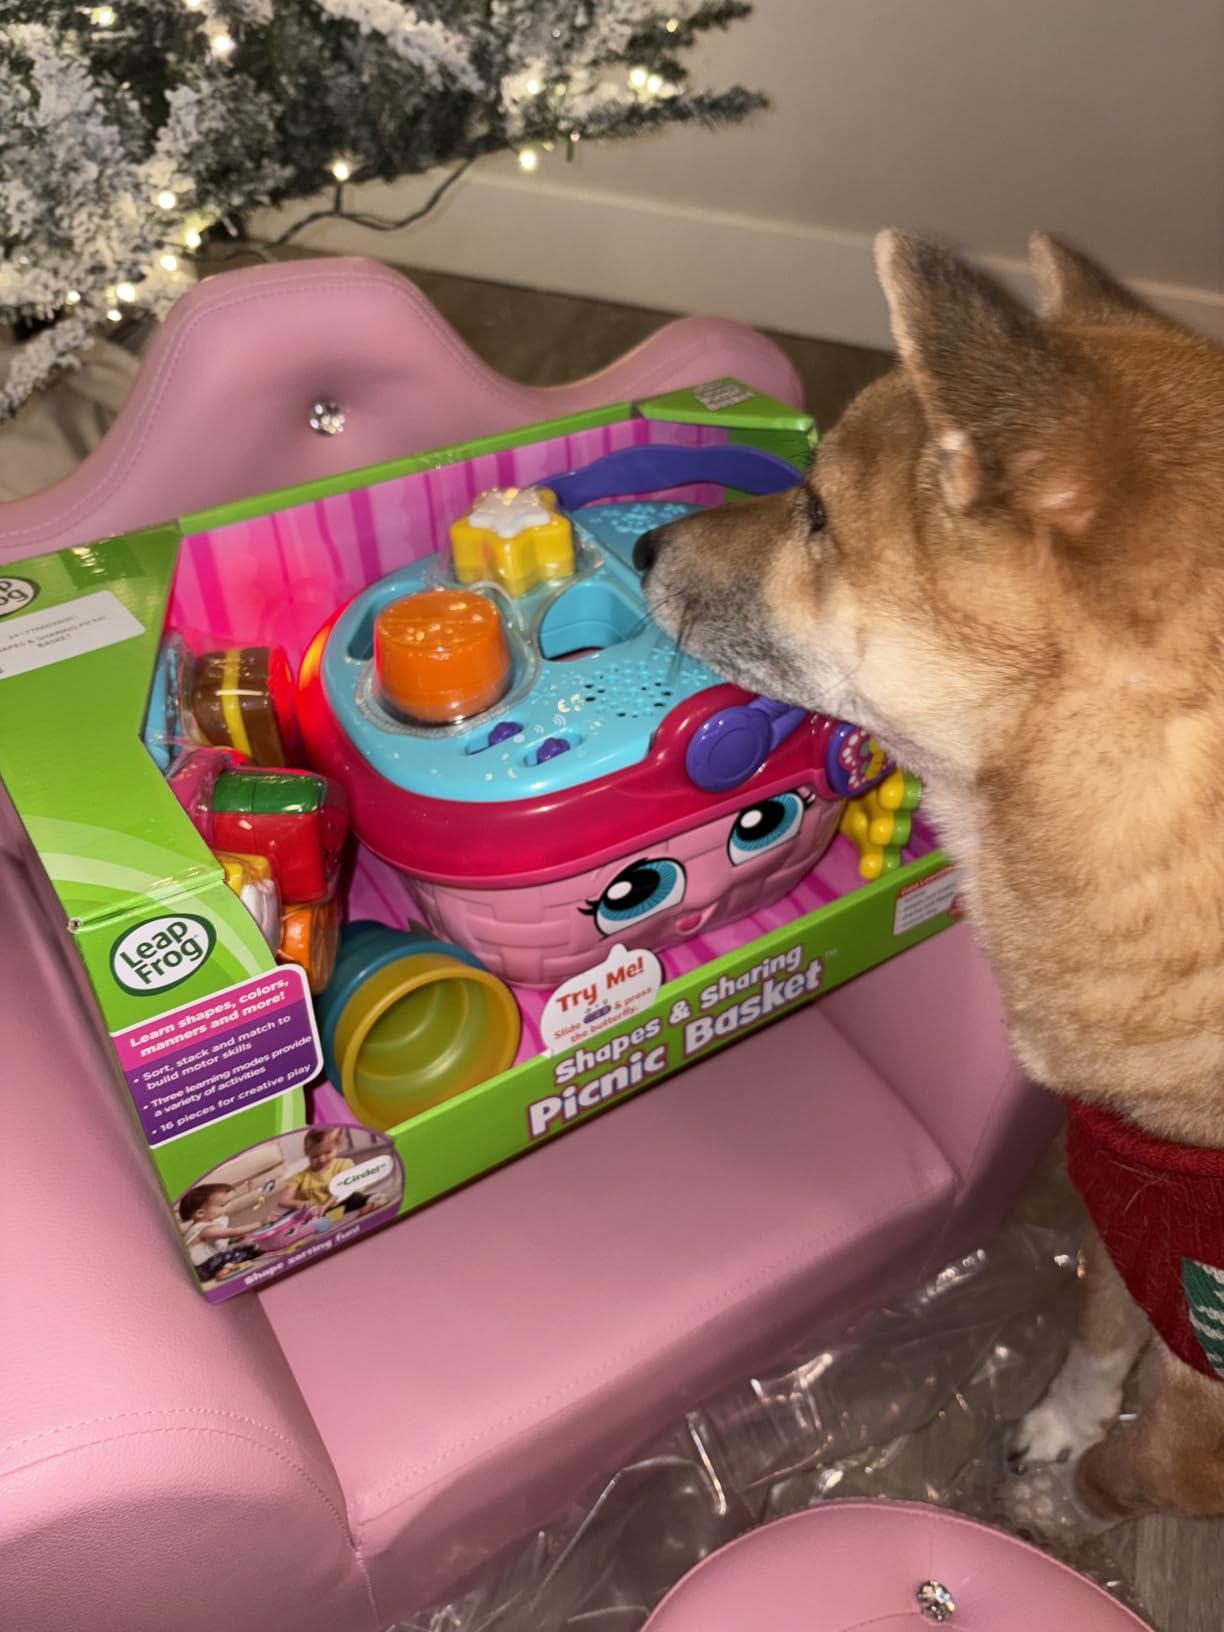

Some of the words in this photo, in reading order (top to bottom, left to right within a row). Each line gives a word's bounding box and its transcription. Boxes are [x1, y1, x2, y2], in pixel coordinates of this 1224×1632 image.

[120, 921, 188, 969] Leap
[134, 936, 203, 985] Frog
[556, 983, 597, 1012] Try
[606, 956, 644, 989] Me!
[129, 1024, 175, 1047] Learn
[178, 1001, 236, 1028] shapes,
[239, 979, 289, 1003] colors,
[140, 1024, 207, 1057] manners
[210, 1011, 239, 1029] and
[242, 991, 285, 1016] more!
[554, 1022, 581, 1039] Slide
[614, 1000, 622, 1010] &
[624, 987, 651, 1005] press
[571, 1030, 588, 1042] the
[669, 999, 692, 1024] &
[143, 1064, 174, 1080] Sort,
[176, 1049, 209, 1067] stack
[212, 1037, 235, 1053] and
[238, 1020, 276, 1042] match
[278, 1014, 292, 1025] to
[146, 1072, 179, 1090] build
[182, 1057, 219, 1075] motor
[222, 1042, 253, 1060] skills
[151, 1090, 184, 1108] Three
[185, 1070, 231, 1093] learning
[232, 1054, 270, 1074] modes
[271, 1035, 312, 1062] provide
[529, 1046, 666, 1137] Picnic
[684, 959, 822, 1054] Basket
[154, 1109, 163, 1118] a
[164, 1093, 202, 1112] variety
[204, 1086, 217, 1097] of
[217, 1066, 267, 1091] activities
[160, 1120, 175, 1132] 16
[176, 1105, 216, 1127] pieces
[217, 1096, 235, 1108] for
[237, 1076, 284, 1100] creative
[287, 1063, 311, 1082] play
[287, 1239, 332, 1264] sorting
